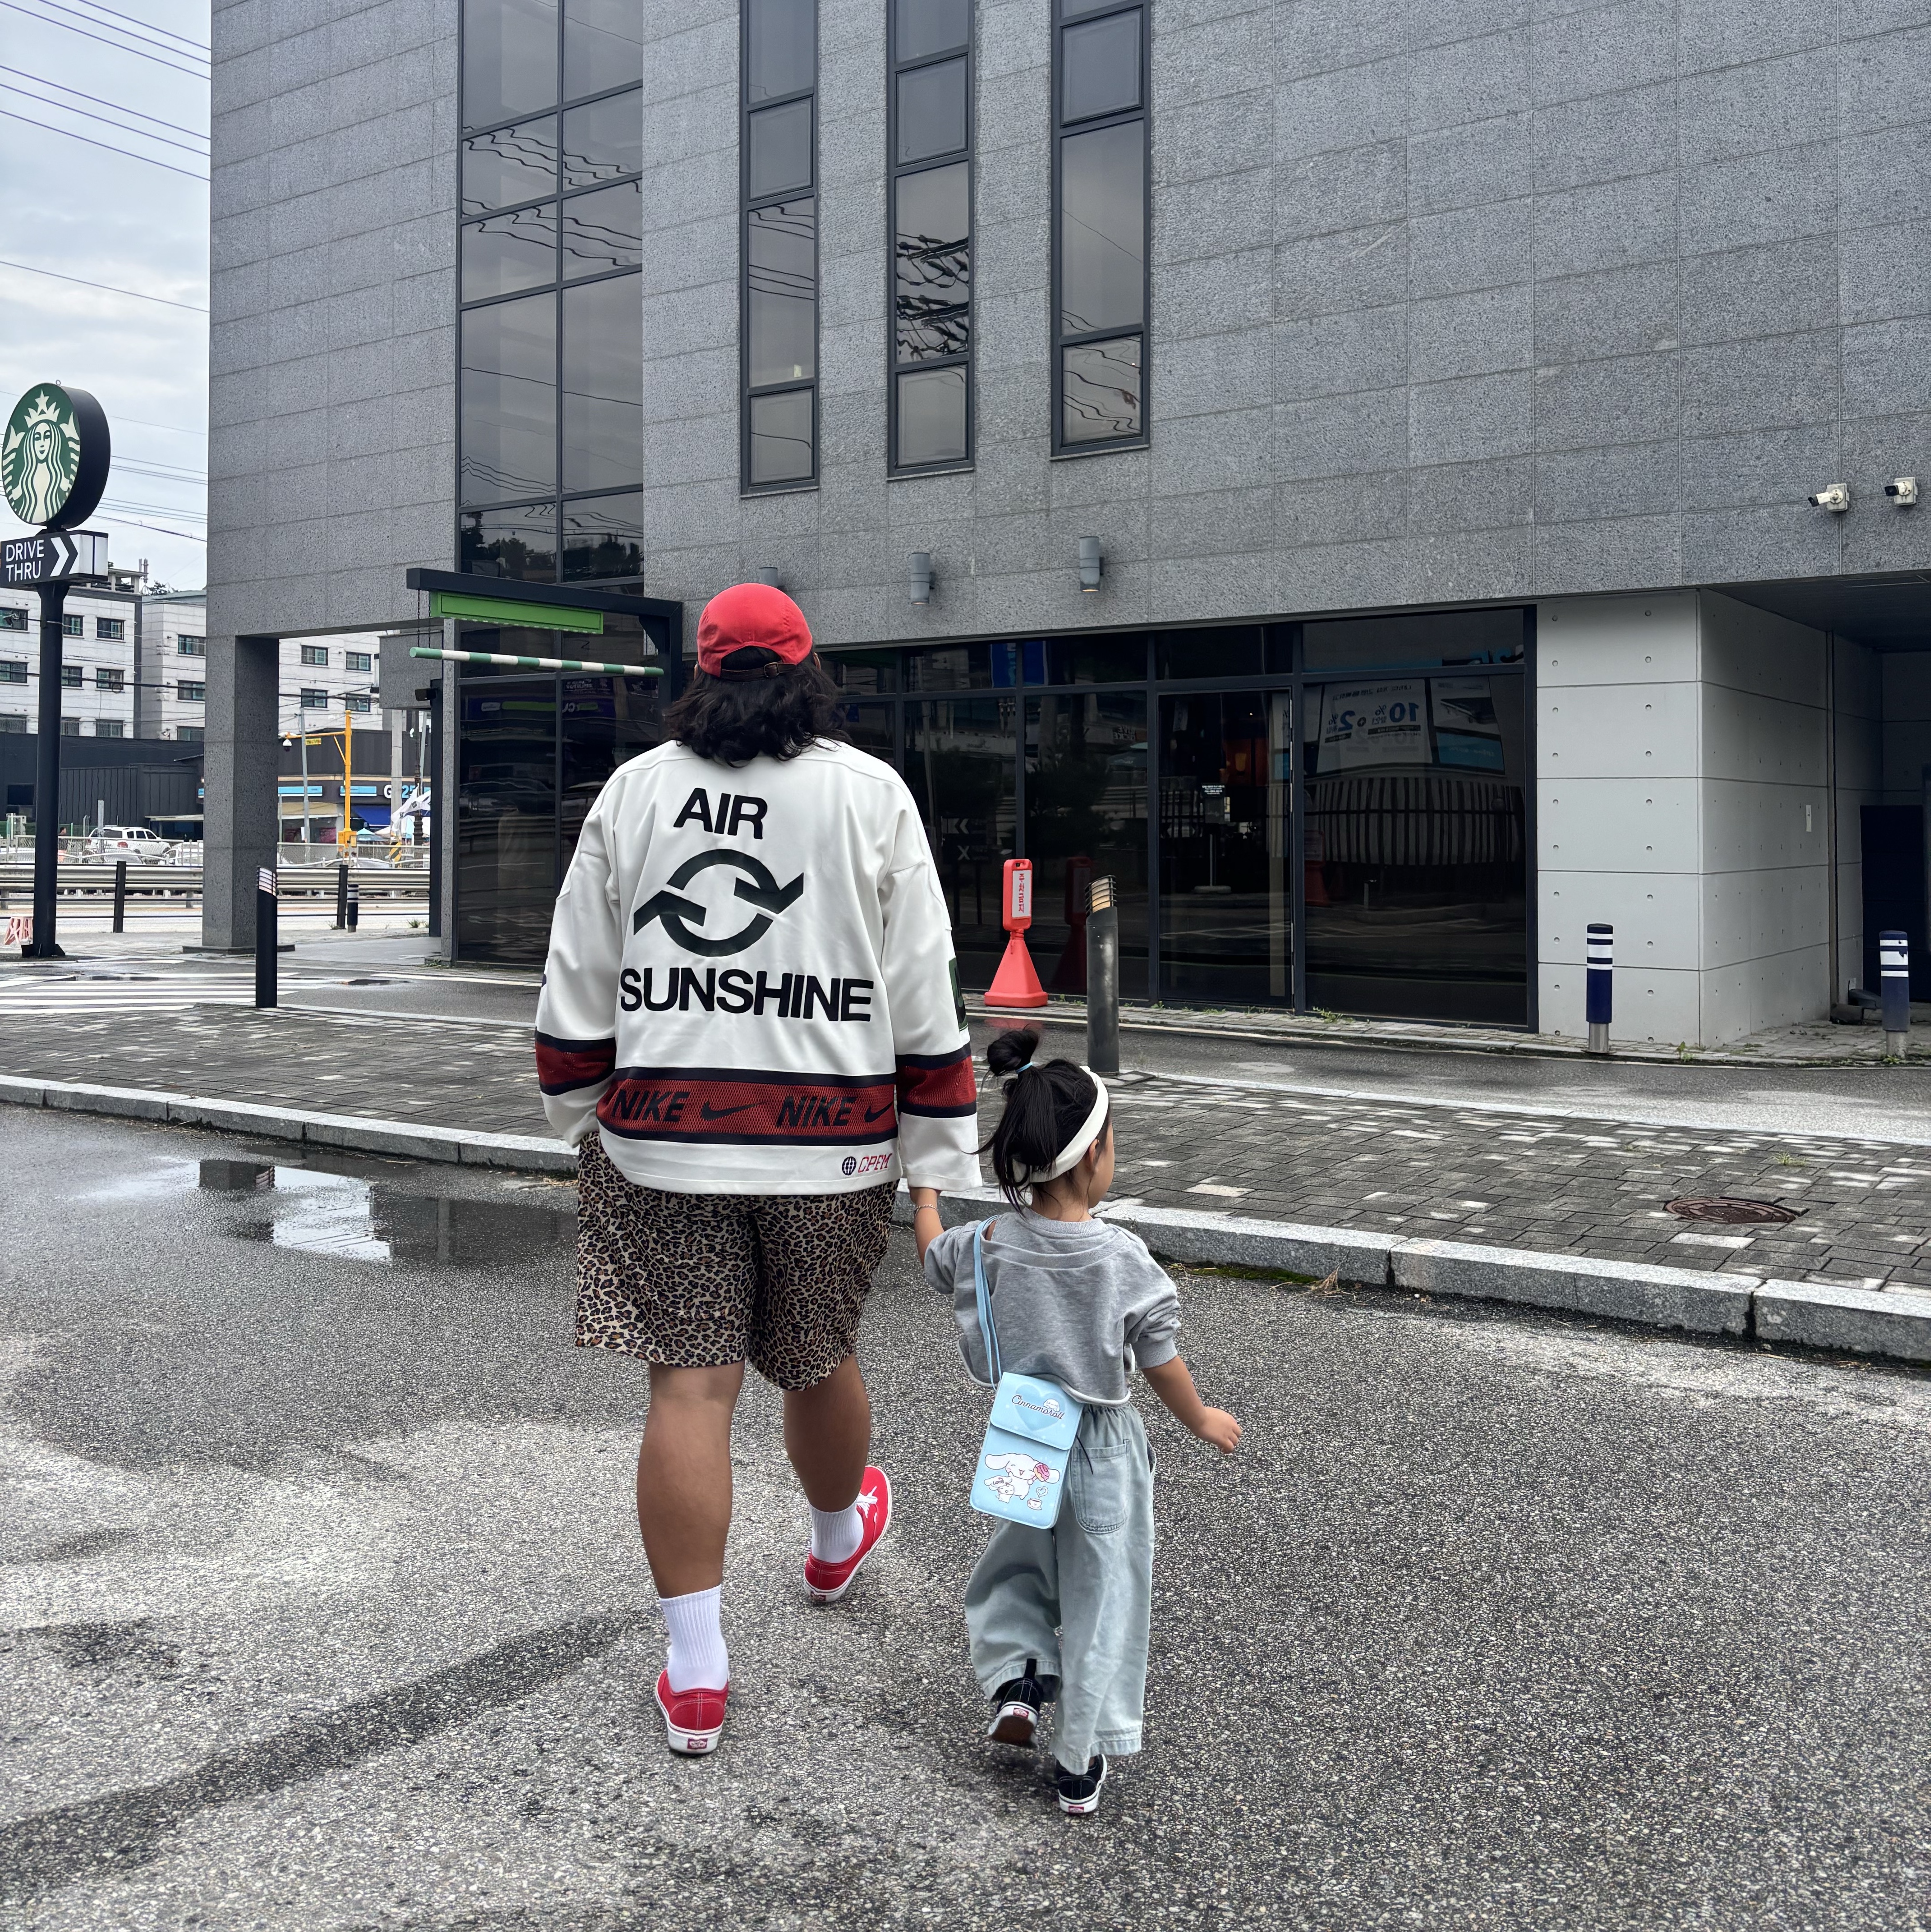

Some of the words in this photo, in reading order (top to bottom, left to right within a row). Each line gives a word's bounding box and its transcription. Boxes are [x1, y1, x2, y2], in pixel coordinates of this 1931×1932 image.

[6, 539, 44, 562] DRIVE
[6, 560, 41, 582] THRU
[674, 788, 767, 840] AIR
[620, 967, 874, 1022] SUNSHINE
[611, 1089, 690, 1123] NIKE
[775, 1095, 858, 1128] NIKE
[858, 1153, 893, 1173] CPFM
[1012, 1395, 1065, 1419] Cinnamoroll
